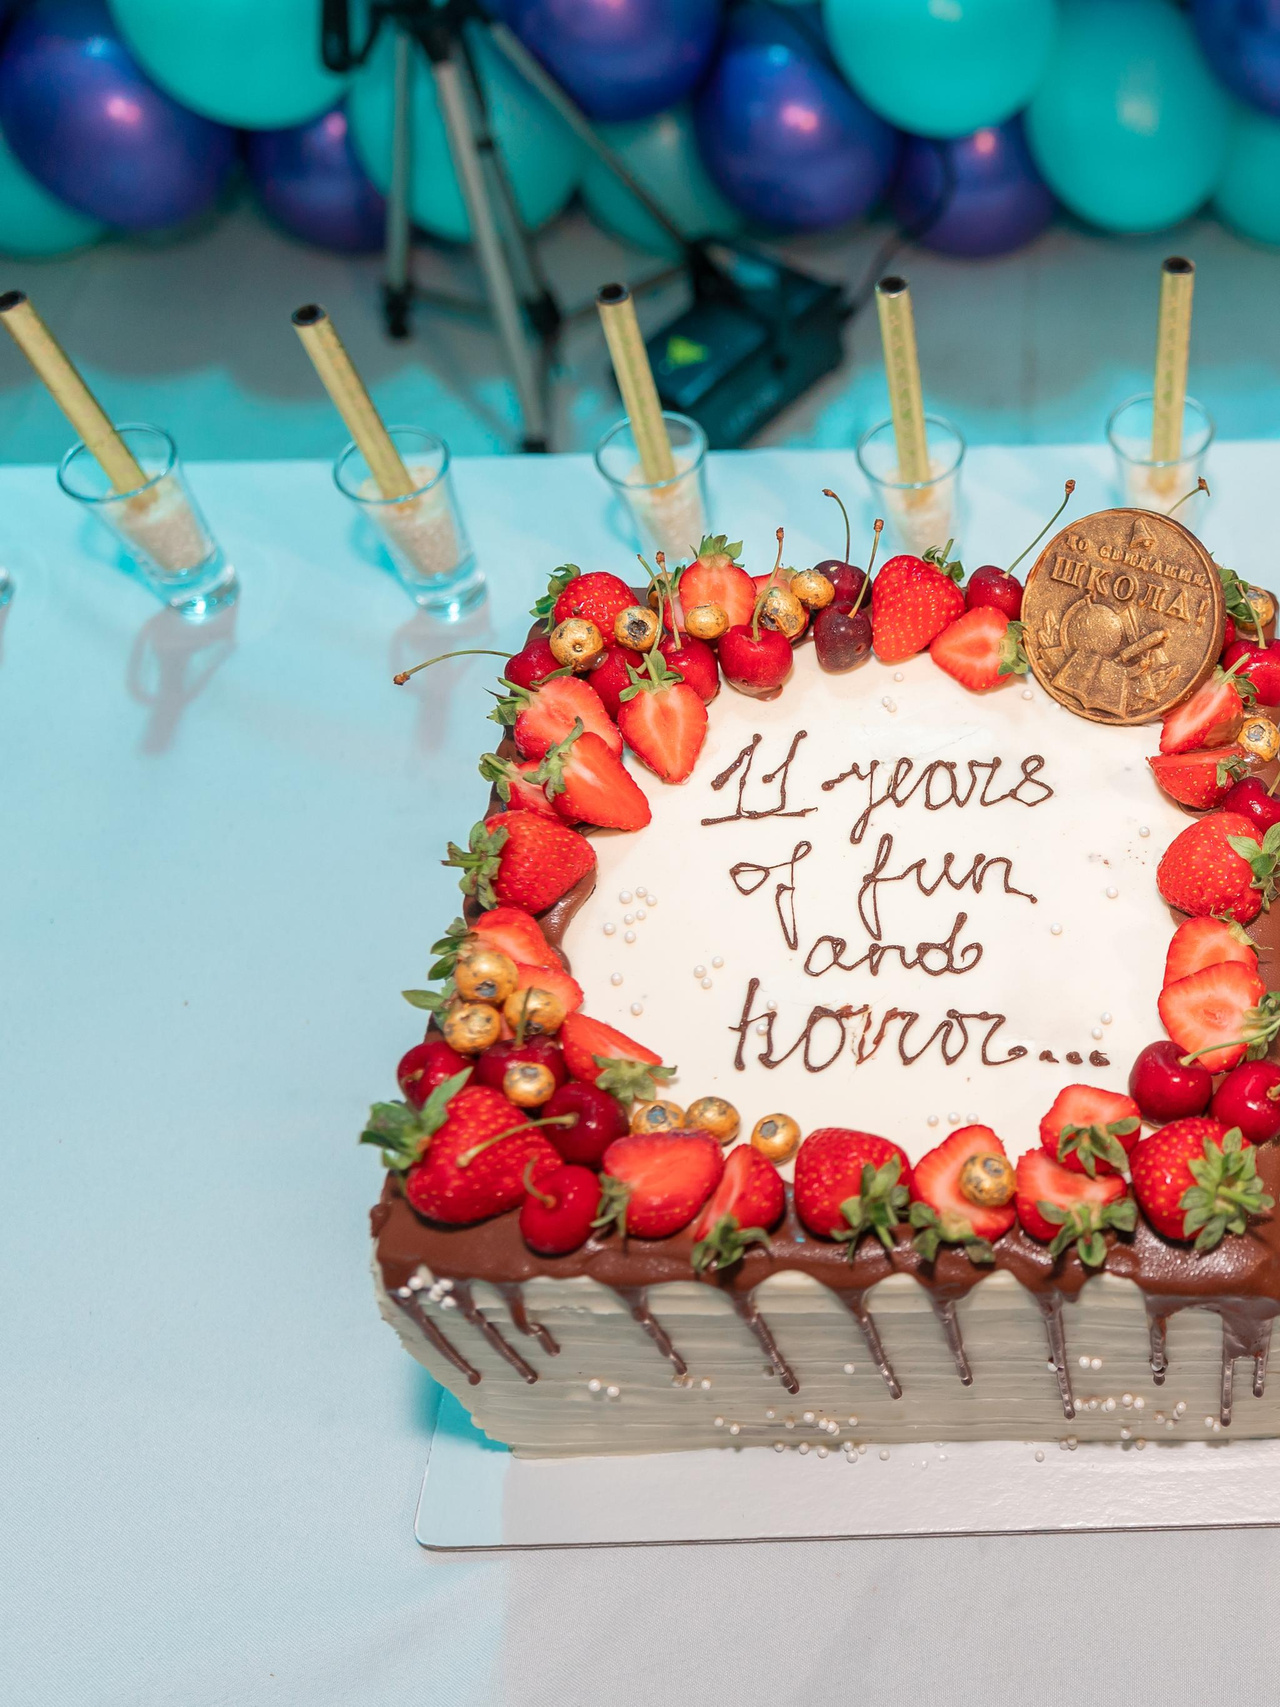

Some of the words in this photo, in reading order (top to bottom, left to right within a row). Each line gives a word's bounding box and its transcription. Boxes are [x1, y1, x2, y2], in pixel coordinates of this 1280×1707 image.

[1050, 553, 1211, 627] ШКОЛА!
[701, 730, 818, 826] 11
[821, 754, 1054, 844] years
[728, 840, 812, 950] of
[857, 833, 1038, 940] fun
[803, 911, 983, 977] and
